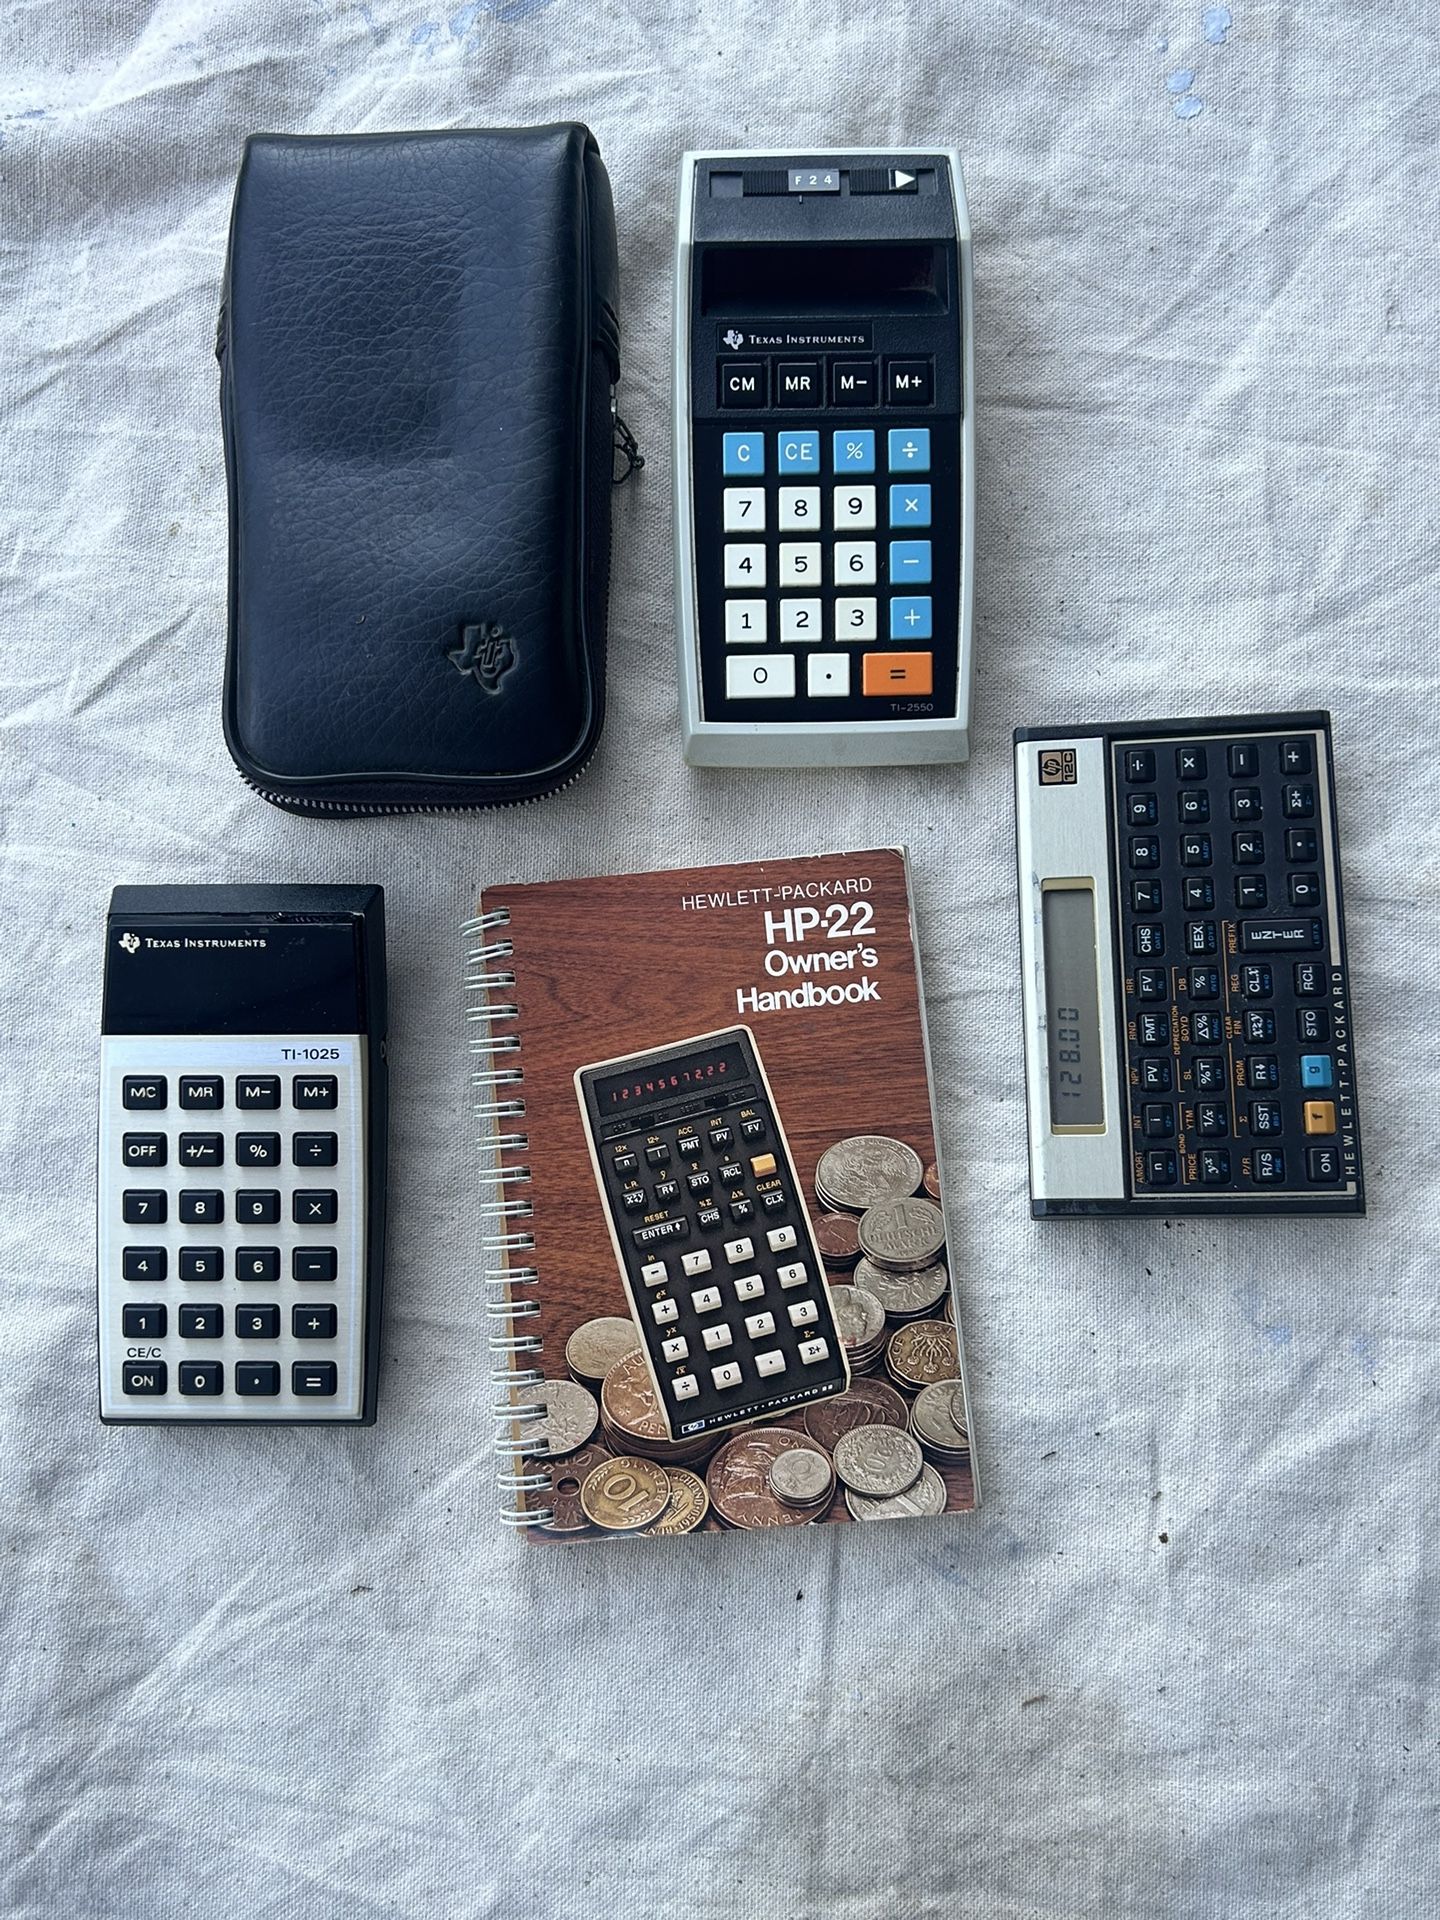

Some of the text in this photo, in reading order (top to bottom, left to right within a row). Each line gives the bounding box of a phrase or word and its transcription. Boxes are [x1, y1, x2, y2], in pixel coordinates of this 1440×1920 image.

[729, 377, 755, 391] CM
[785, 376, 811, 391] MR
[895, 375, 922, 389] M+
[738, 445, 750, 462] C
[785, 444, 813, 460] CE
[846, 442, 863, 459] %
[738, 501, 752, 517] 7
[794, 499, 808, 516] 8
[848, 497, 863, 515] 9
[738, 557, 752, 573] 4
[794, 556, 808, 572] 5
[850, 554, 864, 571] 6
[741, 613, 752, 629] 1
[796, 611, 809, 628] 2
[851, 609, 864, 626] 3
[890, 703, 934, 712] TI-2550
[1064, 752, 1074, 780] 12C
[1133, 804, 1146, 813] 9
[1185, 801, 1198, 811] 6
[1237, 798, 1250, 808] 3
[1135, 847, 1148, 857] 8
[1187, 845, 1200, 854] 5
[1240, 843, 1253, 852] 2
[682, 877, 872, 910] HEWLETT-PACKARD
[1190, 888, 1202, 897] 4
[1296, 884, 1309, 894] 0
[1137, 891, 1150, 901] 7
[1140, 928, 1151, 953] CHS
[1193, 925, 1204, 949] EEX
[1228, 923, 1237, 954] PREFIX
[1251, 929, 1305, 940] ENTER
[764, 943, 878, 977] Owner's
[1142, 976, 1152, 992] FV
[1178, 977, 1187, 991] DB
[1194, 976, 1206, 988] %
[1231, 974, 1239, 992] REG
[1303, 966, 1314, 990] RCL
[1126, 978, 1134, 994] IRR
[736, 976, 882, 1014] Handbook
[1144, 1016, 1156, 1041] PMT
[1172, 1005, 1181, 1055] DEPRECIATION
[1180, 1015, 1189, 1042] SOYD
[1225, 1016, 1233, 1039] CLEAR
[1233, 1020, 1242, 1035] FIN
[1305, 1011, 1317, 1036] STO
[281, 1048, 340, 1060] TI-1025
[1057, 1007, 1082, 1098] 128.00
[1130, 1067, 1139, 1085] NPV
[1147, 1066, 1158, 1082] PV
[1183, 1069, 1191, 1080] SL
[1236, 1060, 1245, 1086] PRGM
[1308, 1066, 1320, 1074] g
[130, 1087, 156, 1097] MC
[188, 1087, 213, 1097] MR
[303, 1086, 329, 1097] M+
[740, 1108, 755, 1118] BAL
[1258, 1105, 1269, 1129] SST
[1311, 1112, 1323, 1120] f
[710, 1117, 723, 1126] INT
[1133, 1114, 1141, 1129] INT
[1186, 1110, 1194, 1130] YTM
[677, 1126, 693, 1136] ACC
[747, 1123, 759, 1133] FV
[715, 1132, 728, 1142] PV
[128, 1145, 157, 1157] OFF
[250, 1144, 267, 1157] %
[681, 1139, 699, 1151] PMT
[1135, 1151, 1144, 1184] AMORT
[1188, 1153, 1197, 1180] PRICE
[1242, 1157, 1250, 1175] P/R
[1261, 1153, 1273, 1176] R/S
[1320, 1153, 1331, 1173] ON
[723, 1166, 741, 1178] RCL
[691, 1176, 710, 1187] STO
[756, 1178, 782, 1192] CLEAR
[138, 1202, 149, 1214] 7
[194, 1202, 205, 1214] 8
[252, 1202, 263, 1215] 9
[644, 1210, 669, 1224] RESET
[700, 1211, 720, 1224] CHS
[778, 1232, 786, 1242] 9
[735, 1244, 743, 1253] 8
[137, 1260, 148, 1272] 4
[195, 1261, 205, 1272] 5
[253, 1261, 263, 1272] 6
[692, 1256, 700, 1266] 7
[789, 1269, 796, 1278] 6
[746, 1281, 754, 1291] 5
[703, 1294, 711, 1303] 4
[800, 1307, 808, 1317] 3
[138, 1318, 146, 1329] 1
[195, 1318, 205, 1330] 2
[252, 1317, 262, 1330] 3
[757, 1319, 765, 1329] 2
[715, 1330, 721, 1340] 1
[127, 1346, 162, 1359] CE/C
[131, 1376, 154, 1387] ON
